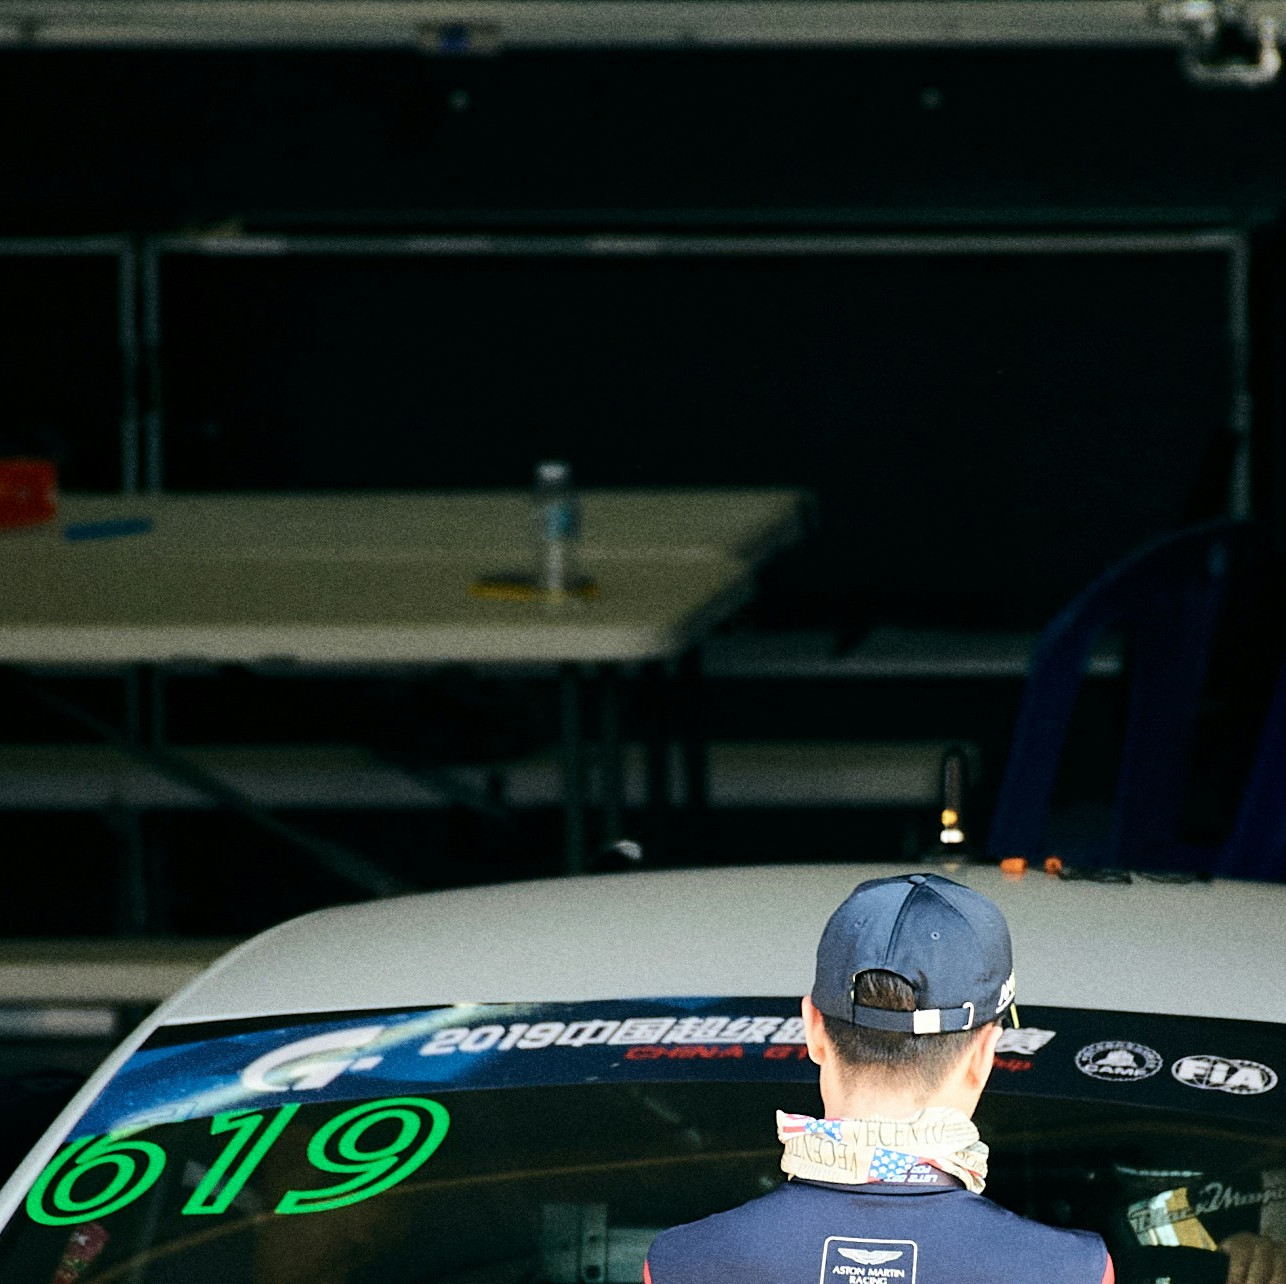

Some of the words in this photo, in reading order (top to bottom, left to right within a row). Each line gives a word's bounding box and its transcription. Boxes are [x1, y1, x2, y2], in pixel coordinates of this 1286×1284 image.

[1177, 1058, 1265, 1091] FIA
[26, 1097, 450, 1226] 619
[832, 1265, 865, 1276] ASTON
[868, 1267, 905, 1278] MARTIN
